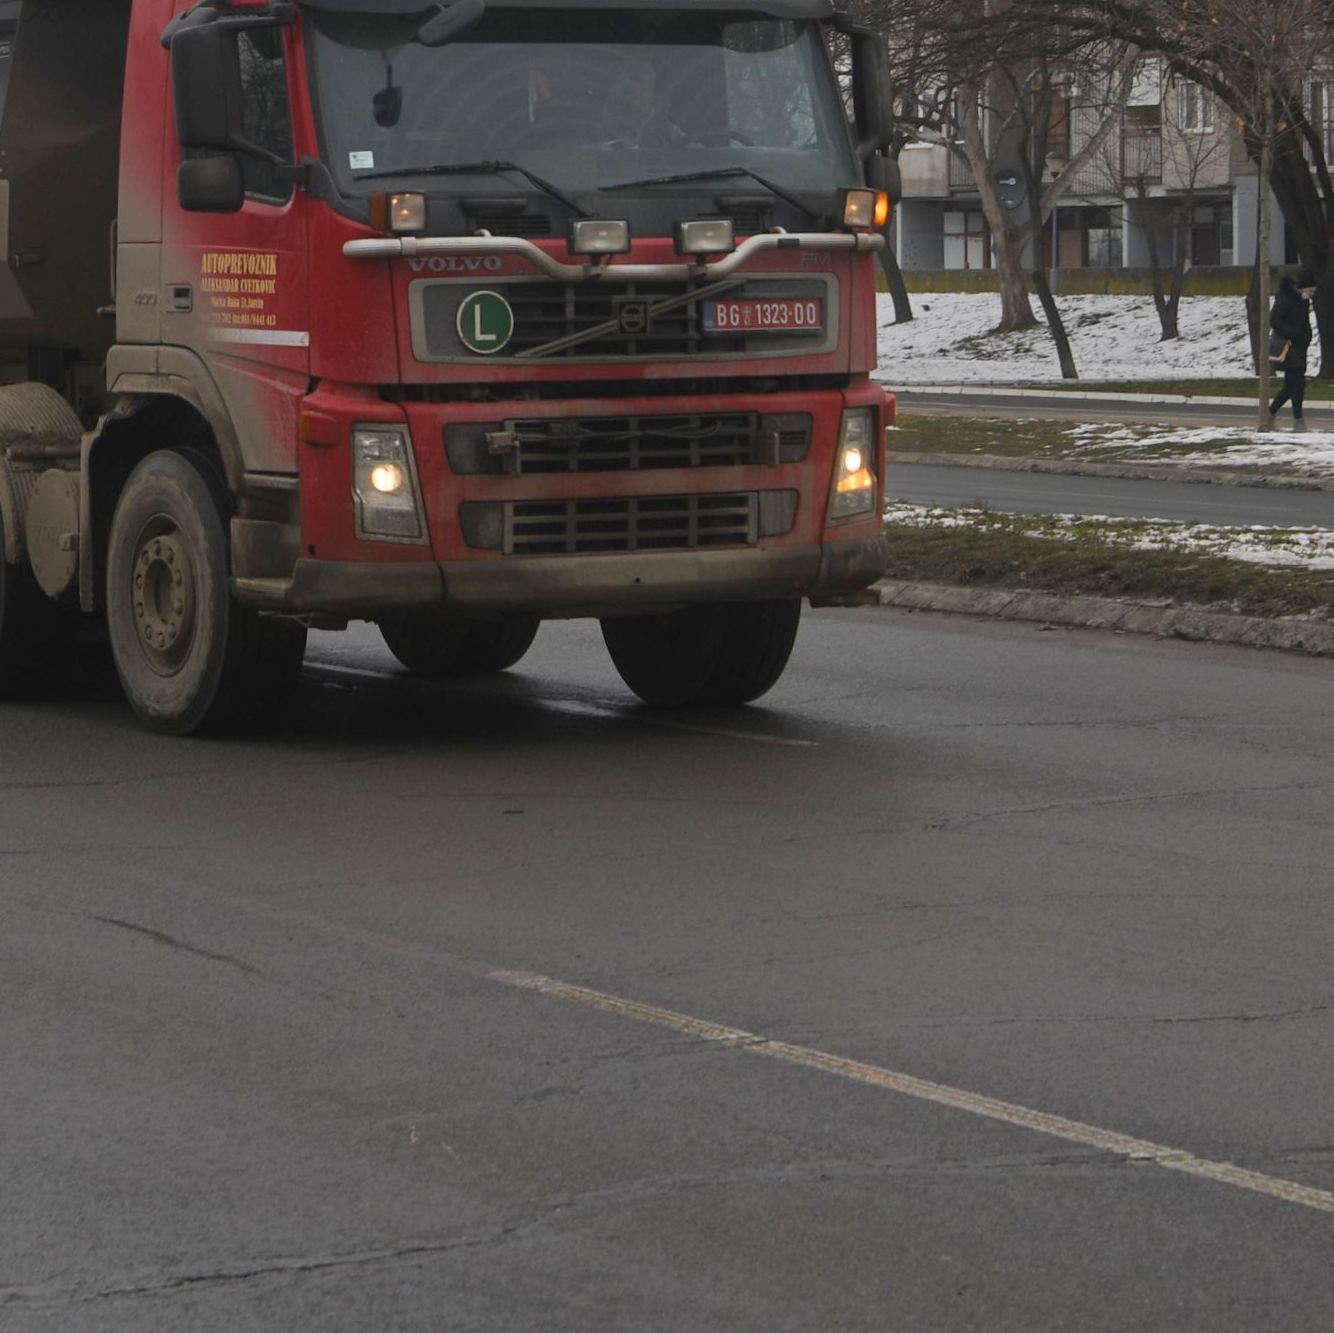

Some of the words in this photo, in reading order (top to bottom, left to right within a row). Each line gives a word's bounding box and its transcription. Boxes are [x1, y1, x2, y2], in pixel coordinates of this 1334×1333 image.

[201, 253, 277, 275] AUTOPREVOZNIK
[405, 256, 502, 273] VOLVO
[202, 278, 240, 292] ALEKSANDAR
[240, 277, 276, 295] CVETKOVIĆ
[474, 304, 497, 341] L
[717, 304, 740, 327] BG
